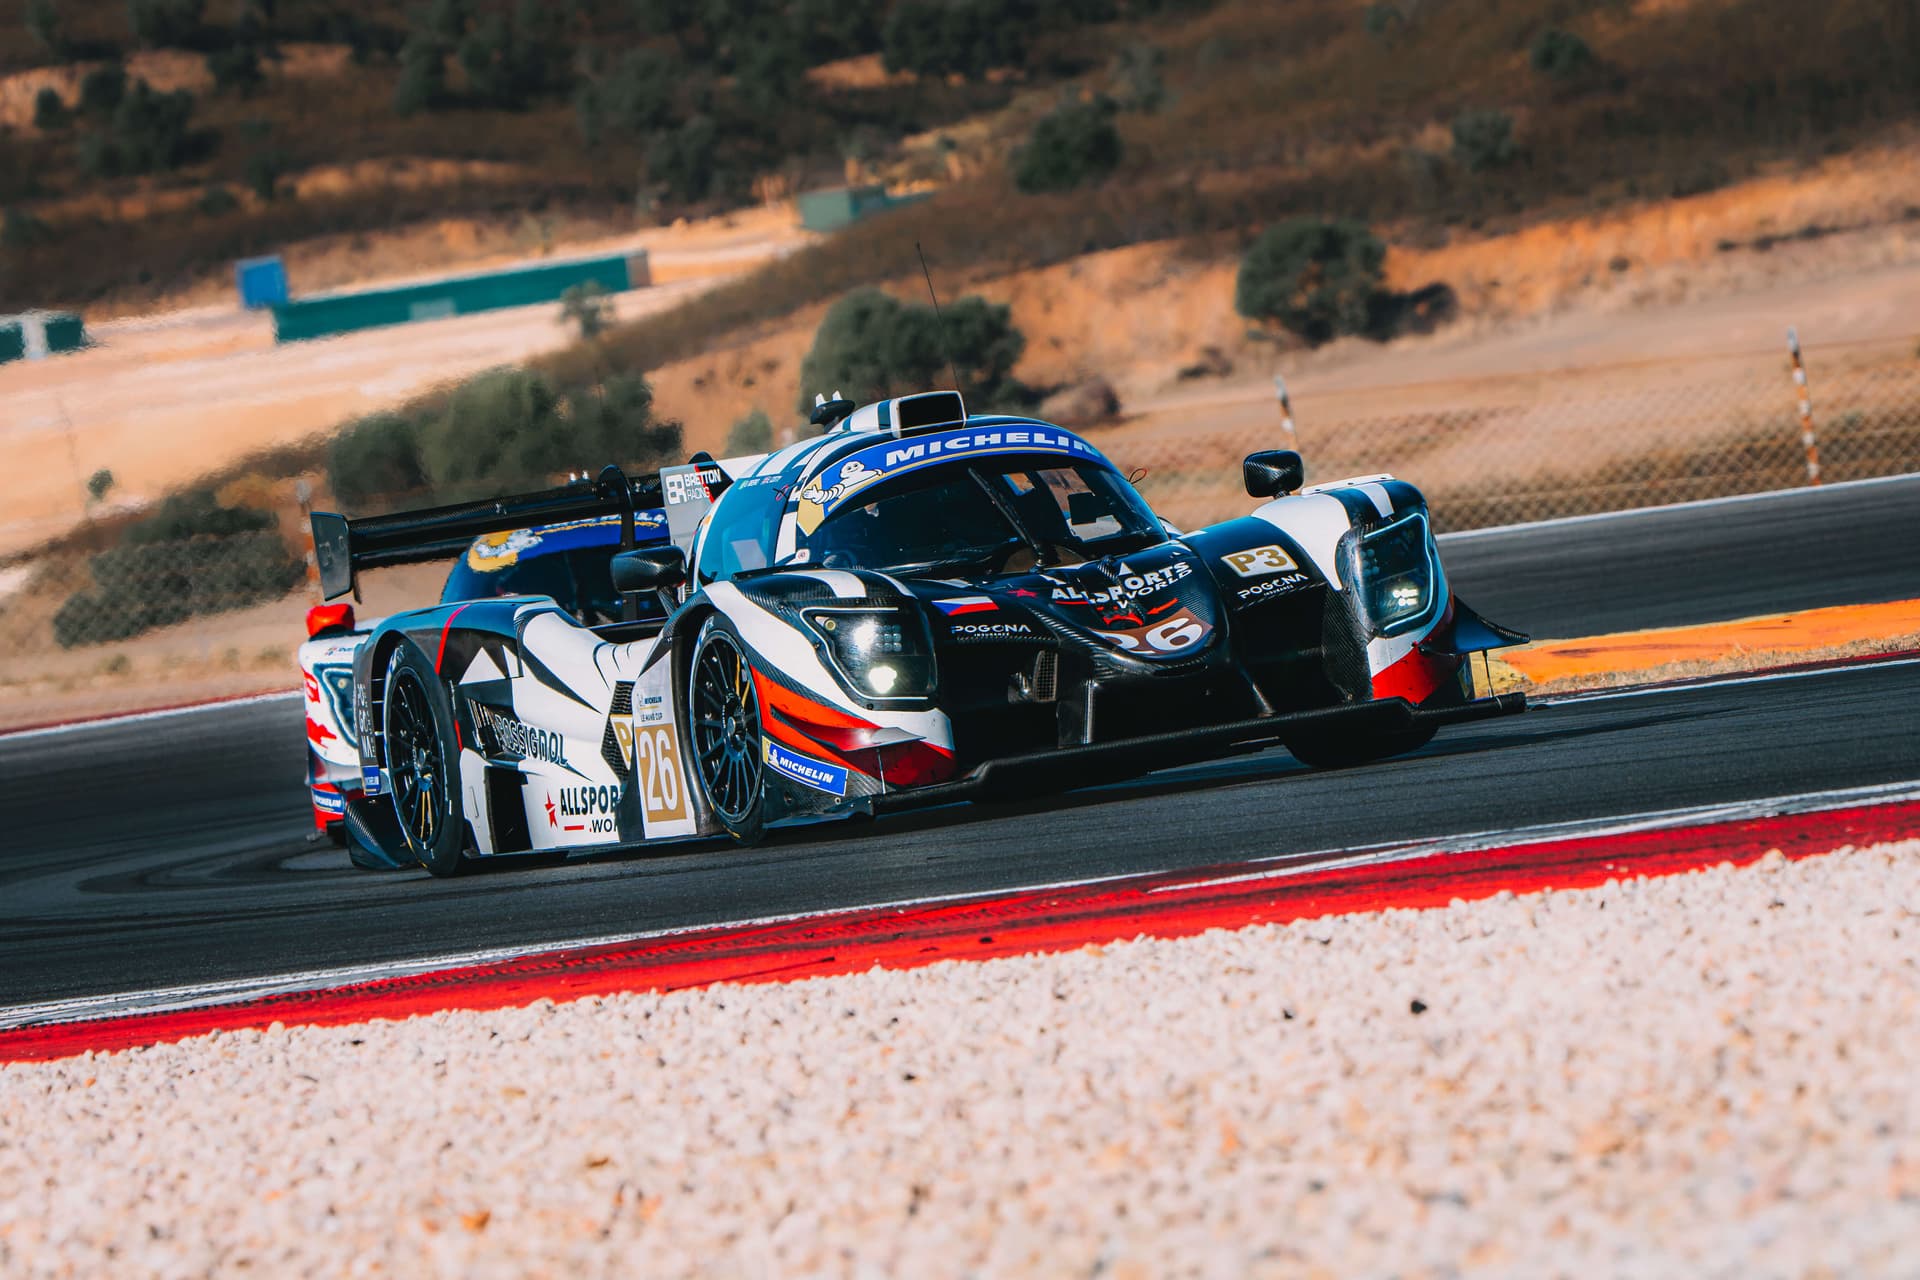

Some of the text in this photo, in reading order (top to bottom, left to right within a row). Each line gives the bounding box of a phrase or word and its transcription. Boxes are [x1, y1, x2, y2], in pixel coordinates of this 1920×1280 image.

[886, 432, 1101, 467] MICHELIN
[684, 469, 721, 488] BRETTON
[687, 486, 711, 501] RACING
[1227, 549, 1288, 573] P3
[615, 721, 632, 763] P
[639, 729, 678, 811] 26
[779, 757, 834, 784] MICHELIN
